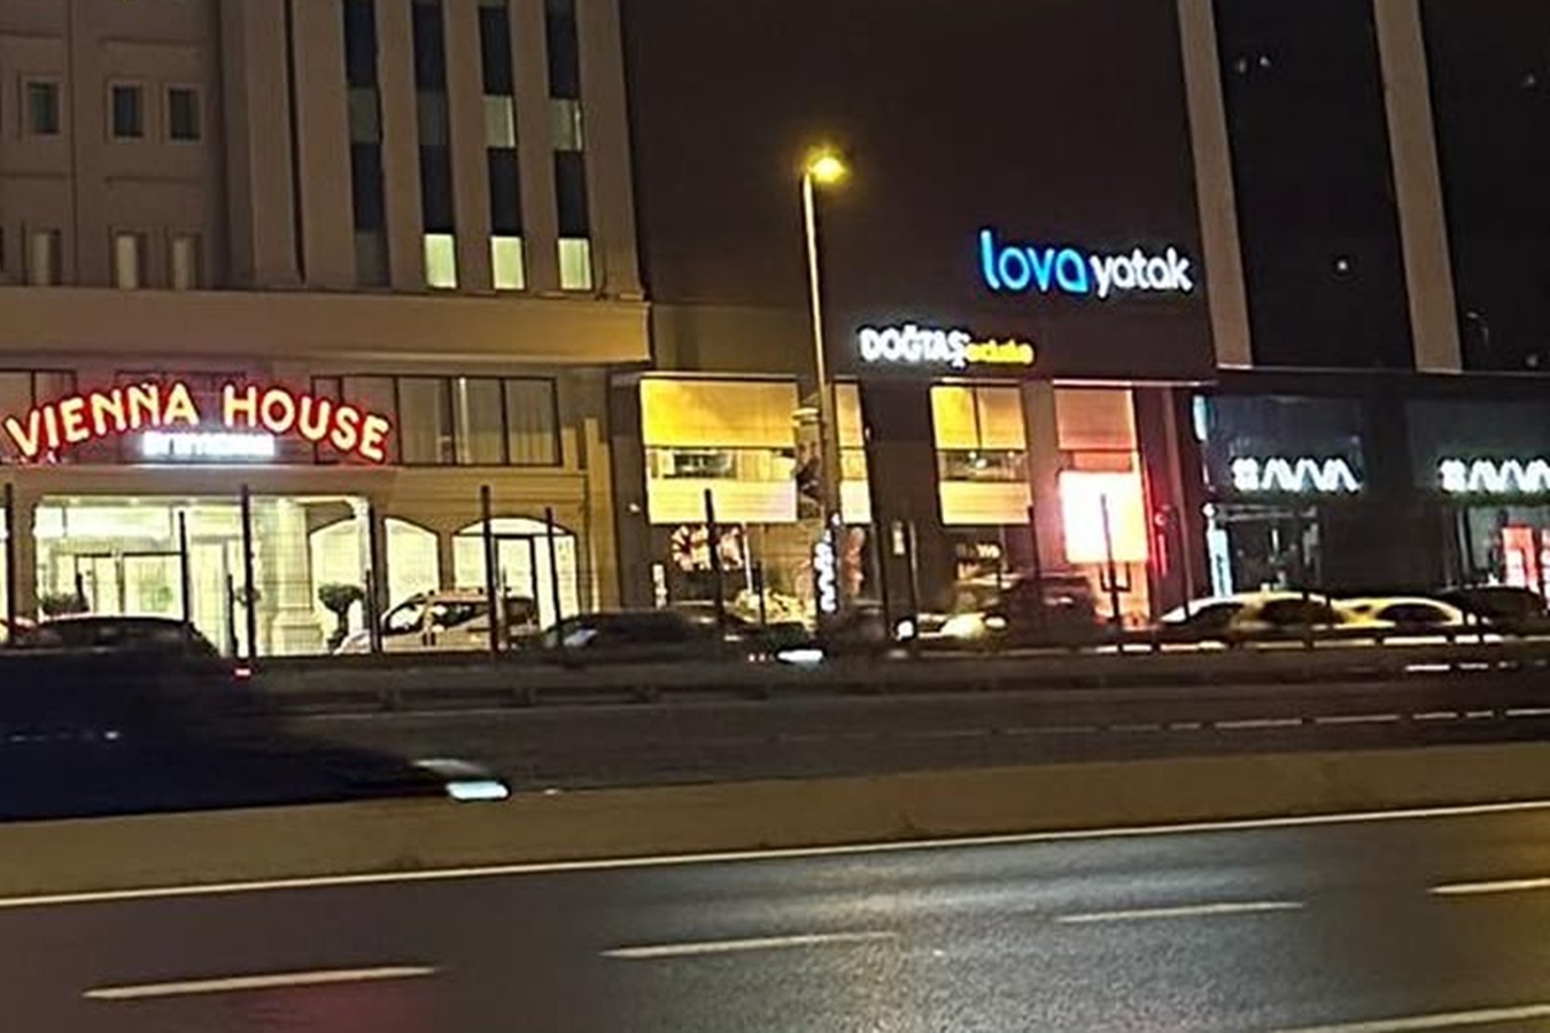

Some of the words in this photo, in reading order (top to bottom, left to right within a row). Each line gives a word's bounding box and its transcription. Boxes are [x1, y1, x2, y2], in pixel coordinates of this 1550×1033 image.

[980, 229, 1088, 293] lova
[1089, 247, 1193, 299] yatak
[5, 382, 201, 458] VIENNA
[222, 384, 390, 461] HOUSE
